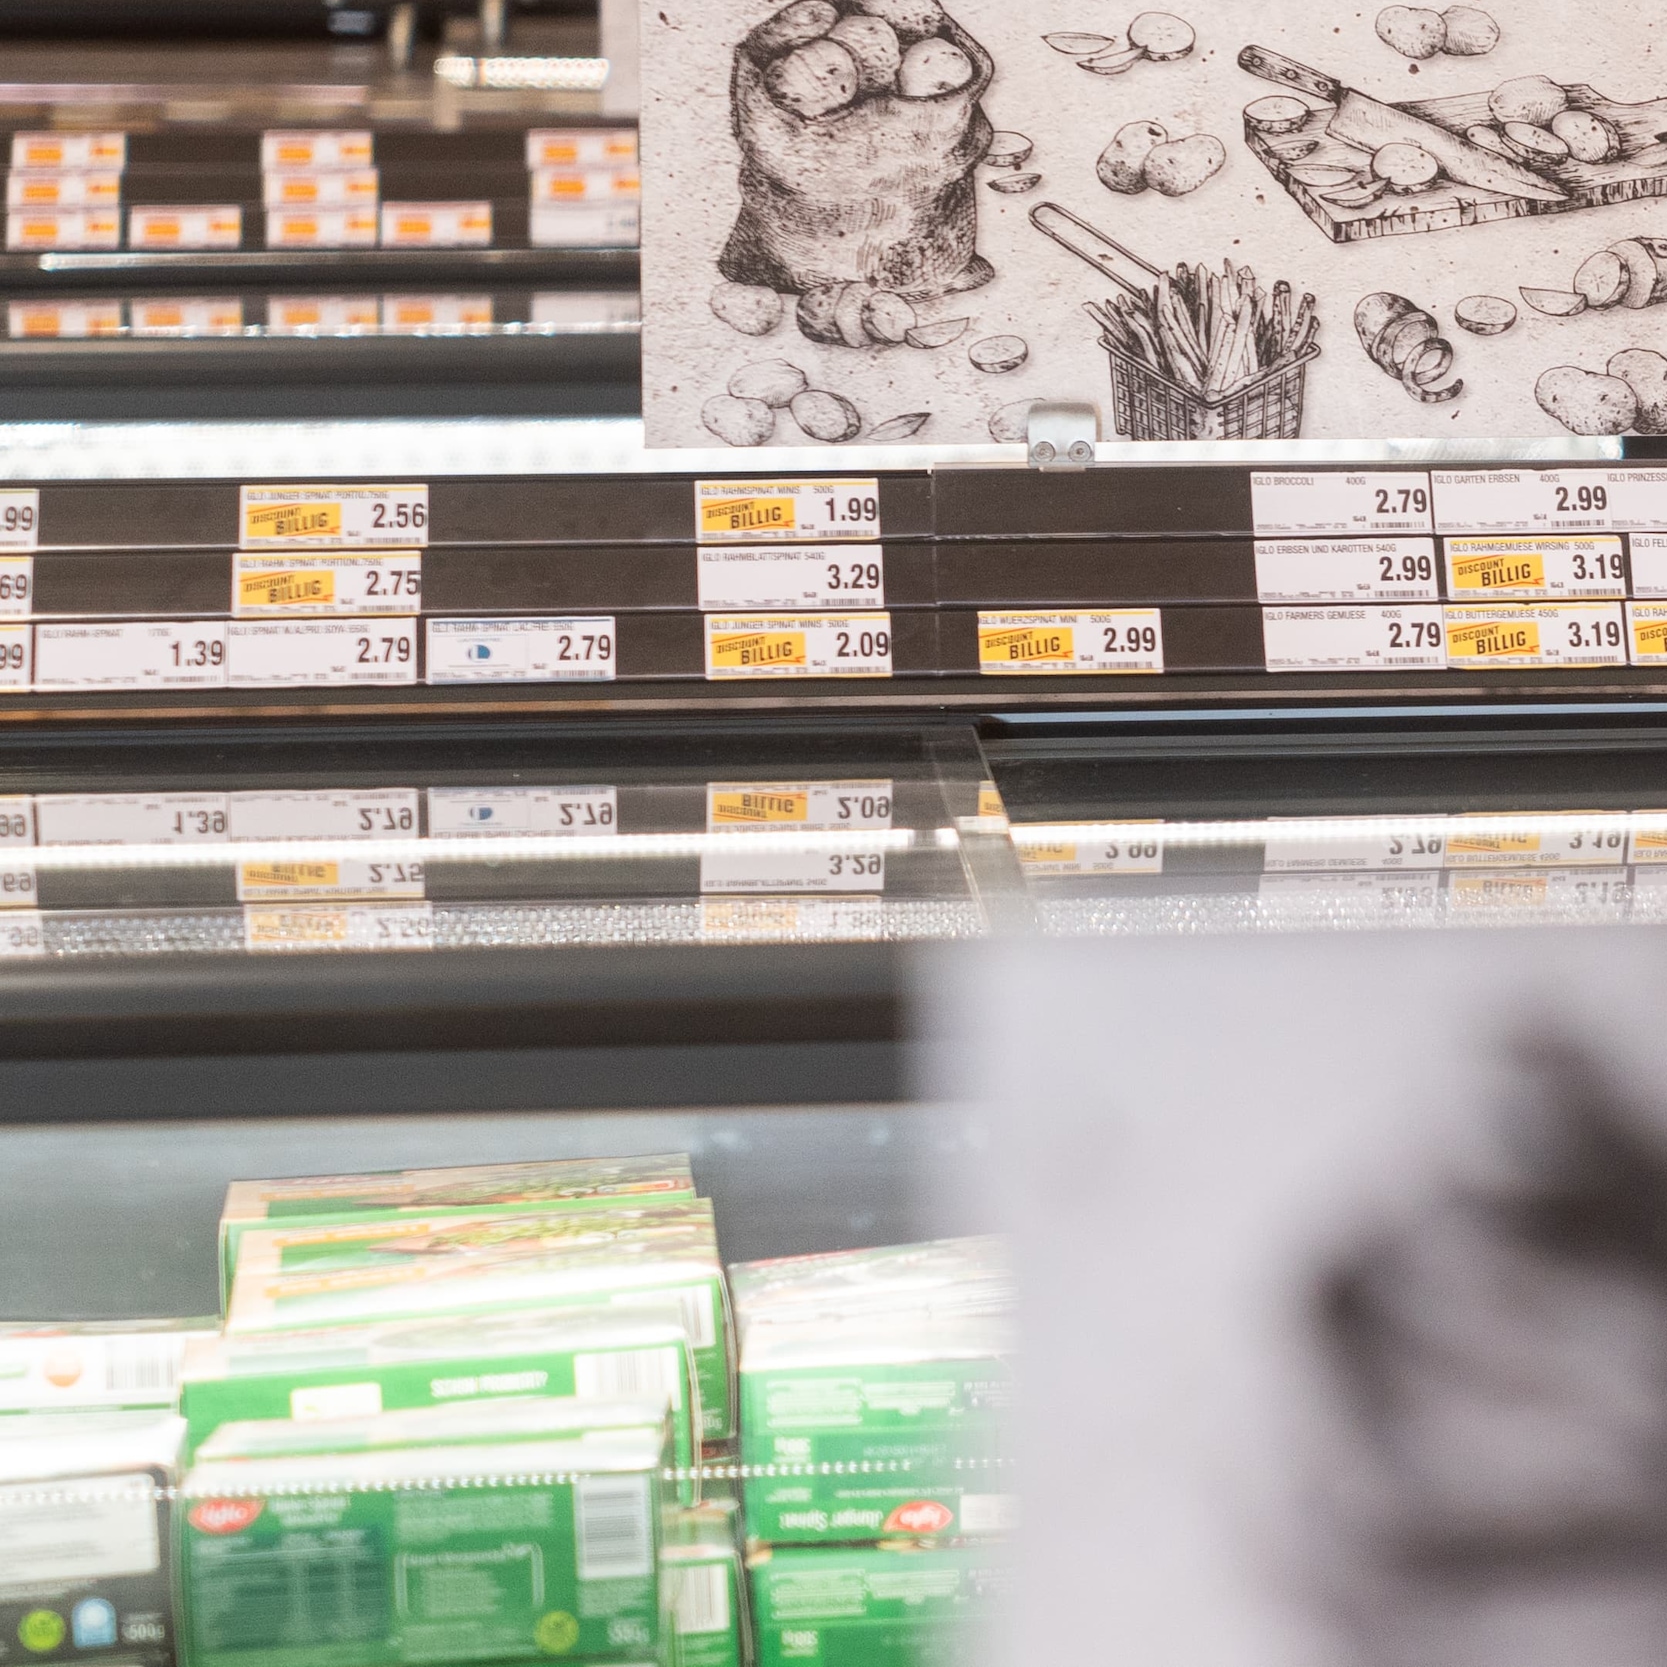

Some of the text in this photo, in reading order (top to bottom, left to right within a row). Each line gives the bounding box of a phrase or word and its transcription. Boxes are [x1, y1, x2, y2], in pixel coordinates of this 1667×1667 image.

[825, 498, 877, 522] 1.99
[1376, 489, 1426, 513] 2.79
[1556, 486, 1607, 511] 2.99
[373, 503, 428, 528] 2.56
[828, 564, 879, 589] 3.29
[1380, 556, 1431, 581] 2.99
[1458, 560, 1504, 575] DISCOUNT
[1482, 563, 1531, 586] BILLIG
[1573, 554, 1623, 580] 3.19
[366, 571, 420, 596] 2.75
[836, 632, 889, 657] 2.09
[1104, 627, 1155, 652] 2.99
[1389, 622, 1440, 647] 2.79
[1453, 626, 1499, 643] DISCOUNT
[1477, 632, 1526, 655] BILLIG
[1569, 622, 1619, 647] 3.19
[172, 640, 225, 666] 1.39
[358, 637, 410, 662] 2.79
[559, 635, 610, 660] 2.79
[1010, 637, 1060, 660] BILLIG
